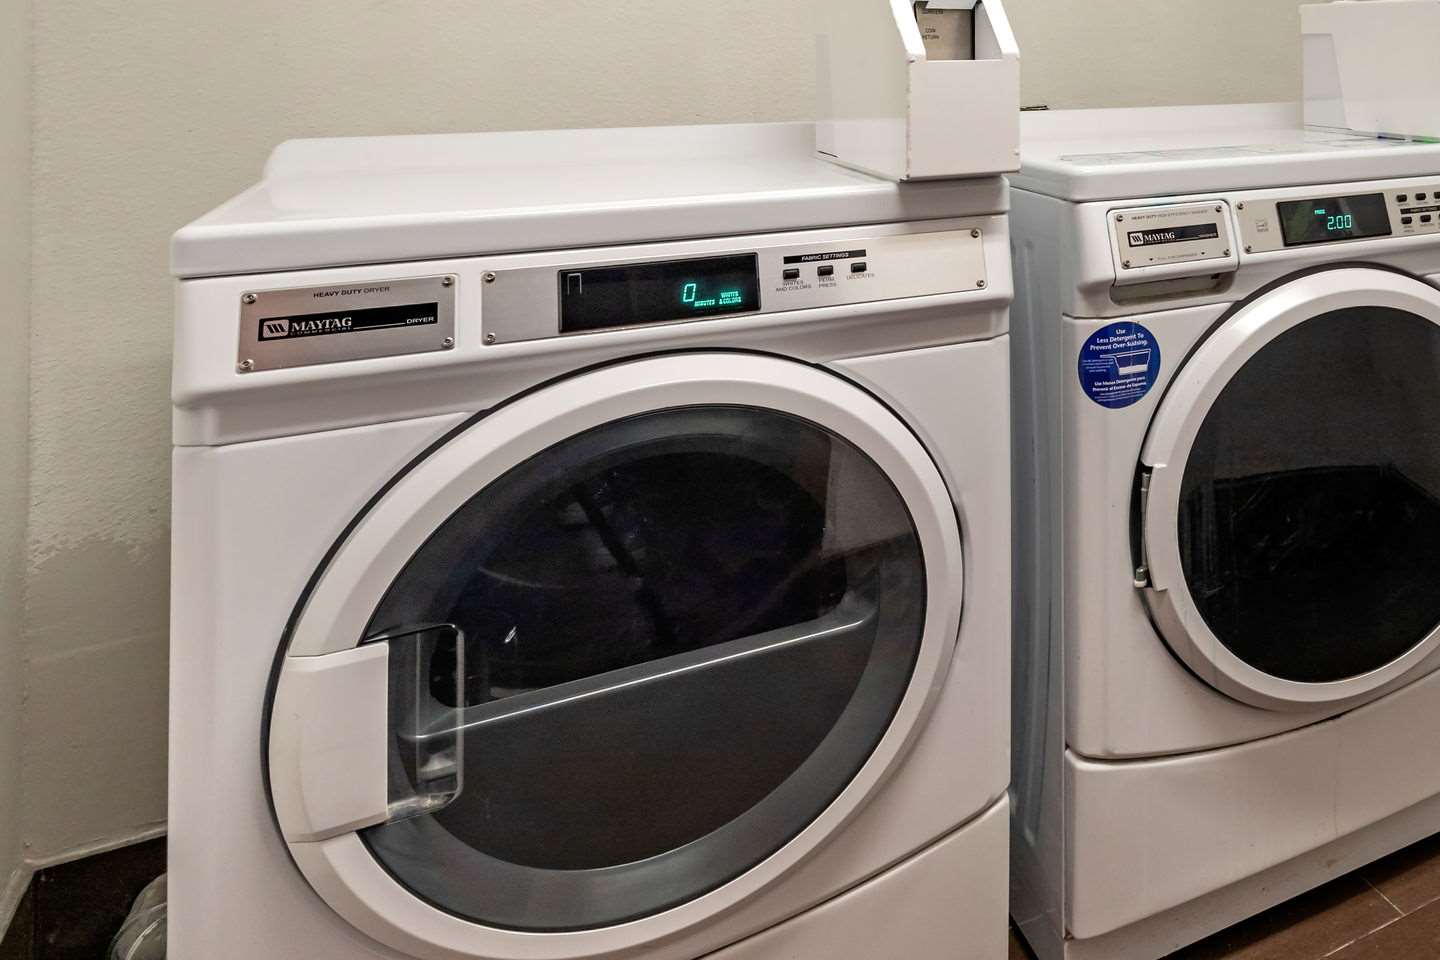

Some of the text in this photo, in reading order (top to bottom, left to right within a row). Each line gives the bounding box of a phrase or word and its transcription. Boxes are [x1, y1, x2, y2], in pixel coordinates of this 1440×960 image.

[1327, 214, 1352, 230] 2.00
[1143, 232, 1176, 242] MAYTAG
[801, 254, 822, 262] FABRIC
[313, 286, 390, 299] HEAVY DUTY DRYER
[683, 283, 697, 303] 0
[290, 317, 352, 332] MAYTAG
[406, 316, 436, 325] DRYER
[1109, 334, 1137, 343] Detergent
